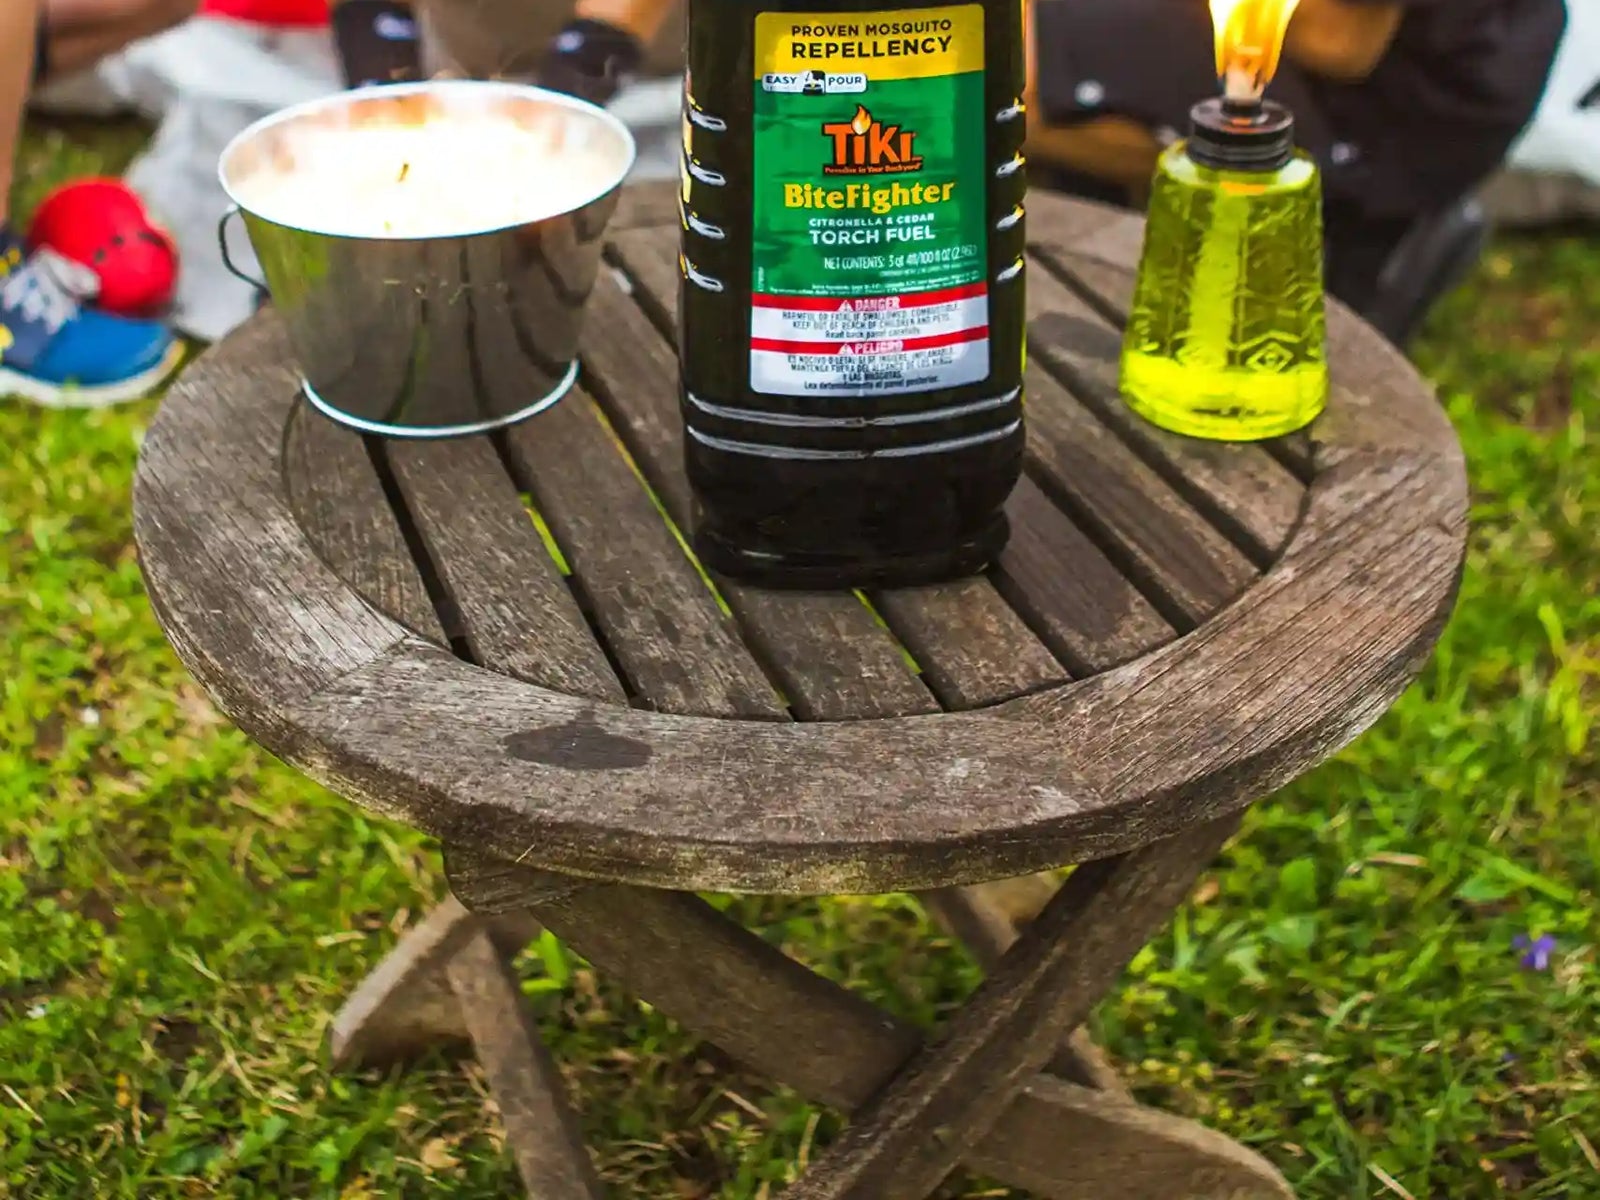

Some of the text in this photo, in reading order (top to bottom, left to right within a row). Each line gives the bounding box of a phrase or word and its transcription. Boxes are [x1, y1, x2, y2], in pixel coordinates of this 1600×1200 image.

[792, 19, 952, 37] PROVEN MOSQUITO
[792, 35, 952, 58] REPELLENCY
[766, 75, 862, 85] EASY POUR
[784, 182, 955, 214] BiteFighter
[809, 218, 883, 227] CITRONELLA
[896, 212, 935, 225] CEDAR
[809, 225, 936, 245] TORCH FUEL
[824, 257, 840, 269] NET
[855, 296, 901, 311] DANGER
